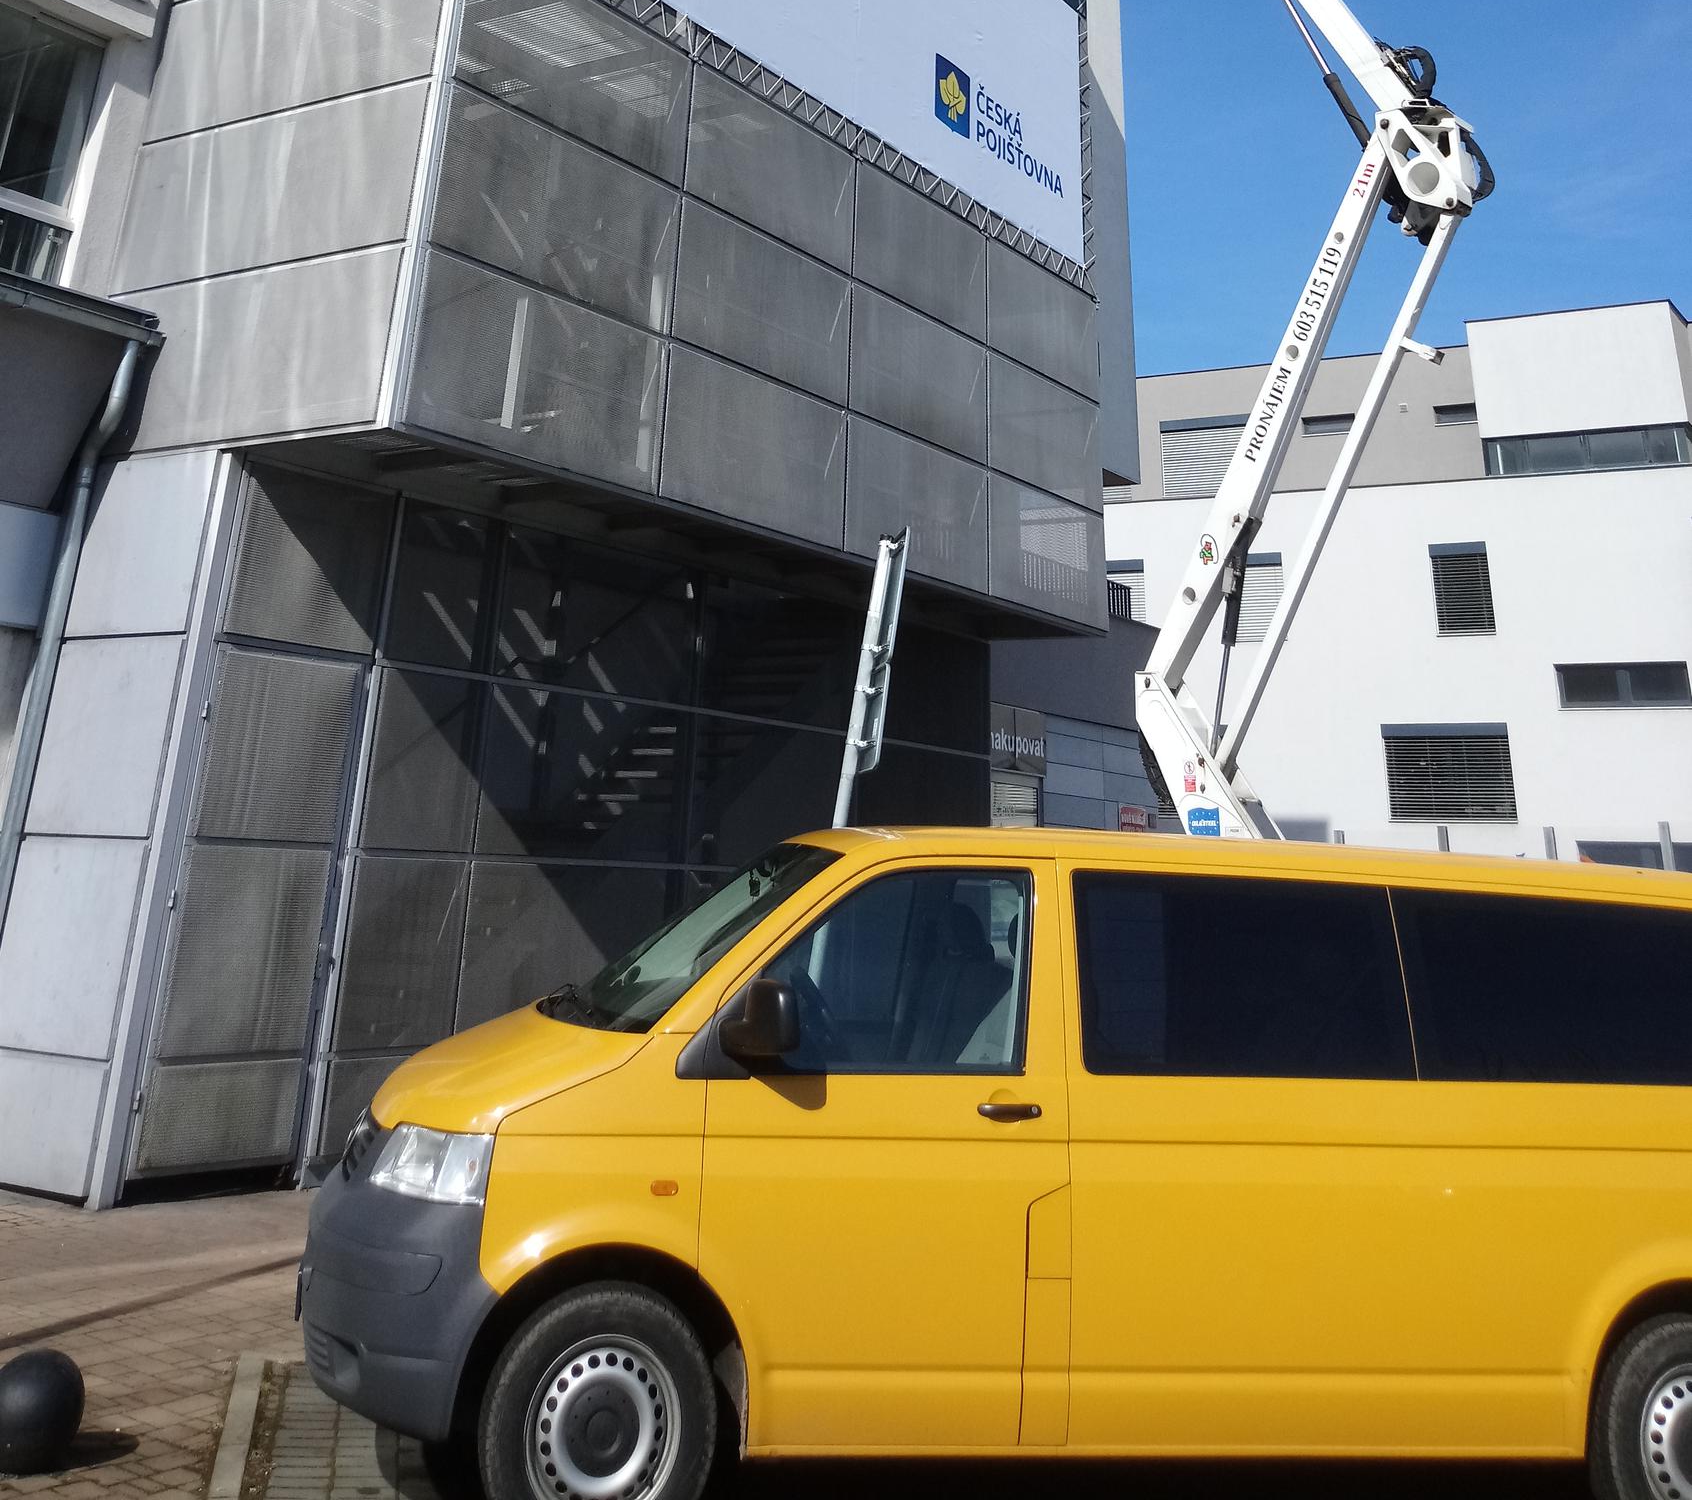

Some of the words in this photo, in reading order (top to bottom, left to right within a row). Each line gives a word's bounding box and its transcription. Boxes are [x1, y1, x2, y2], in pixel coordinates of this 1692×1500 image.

[976, 83, 1023, 142] ČESKÁ
[976, 119, 1064, 199] POJIŠŤOVNA
[1352, 162, 1375, 198] 21m
[1318, 247, 1342, 278] 119
[1304, 278, 1329, 309] 515
[1293, 310, 1316, 342] 603
[1244, 366, 1292, 463] PRONÁJEM
